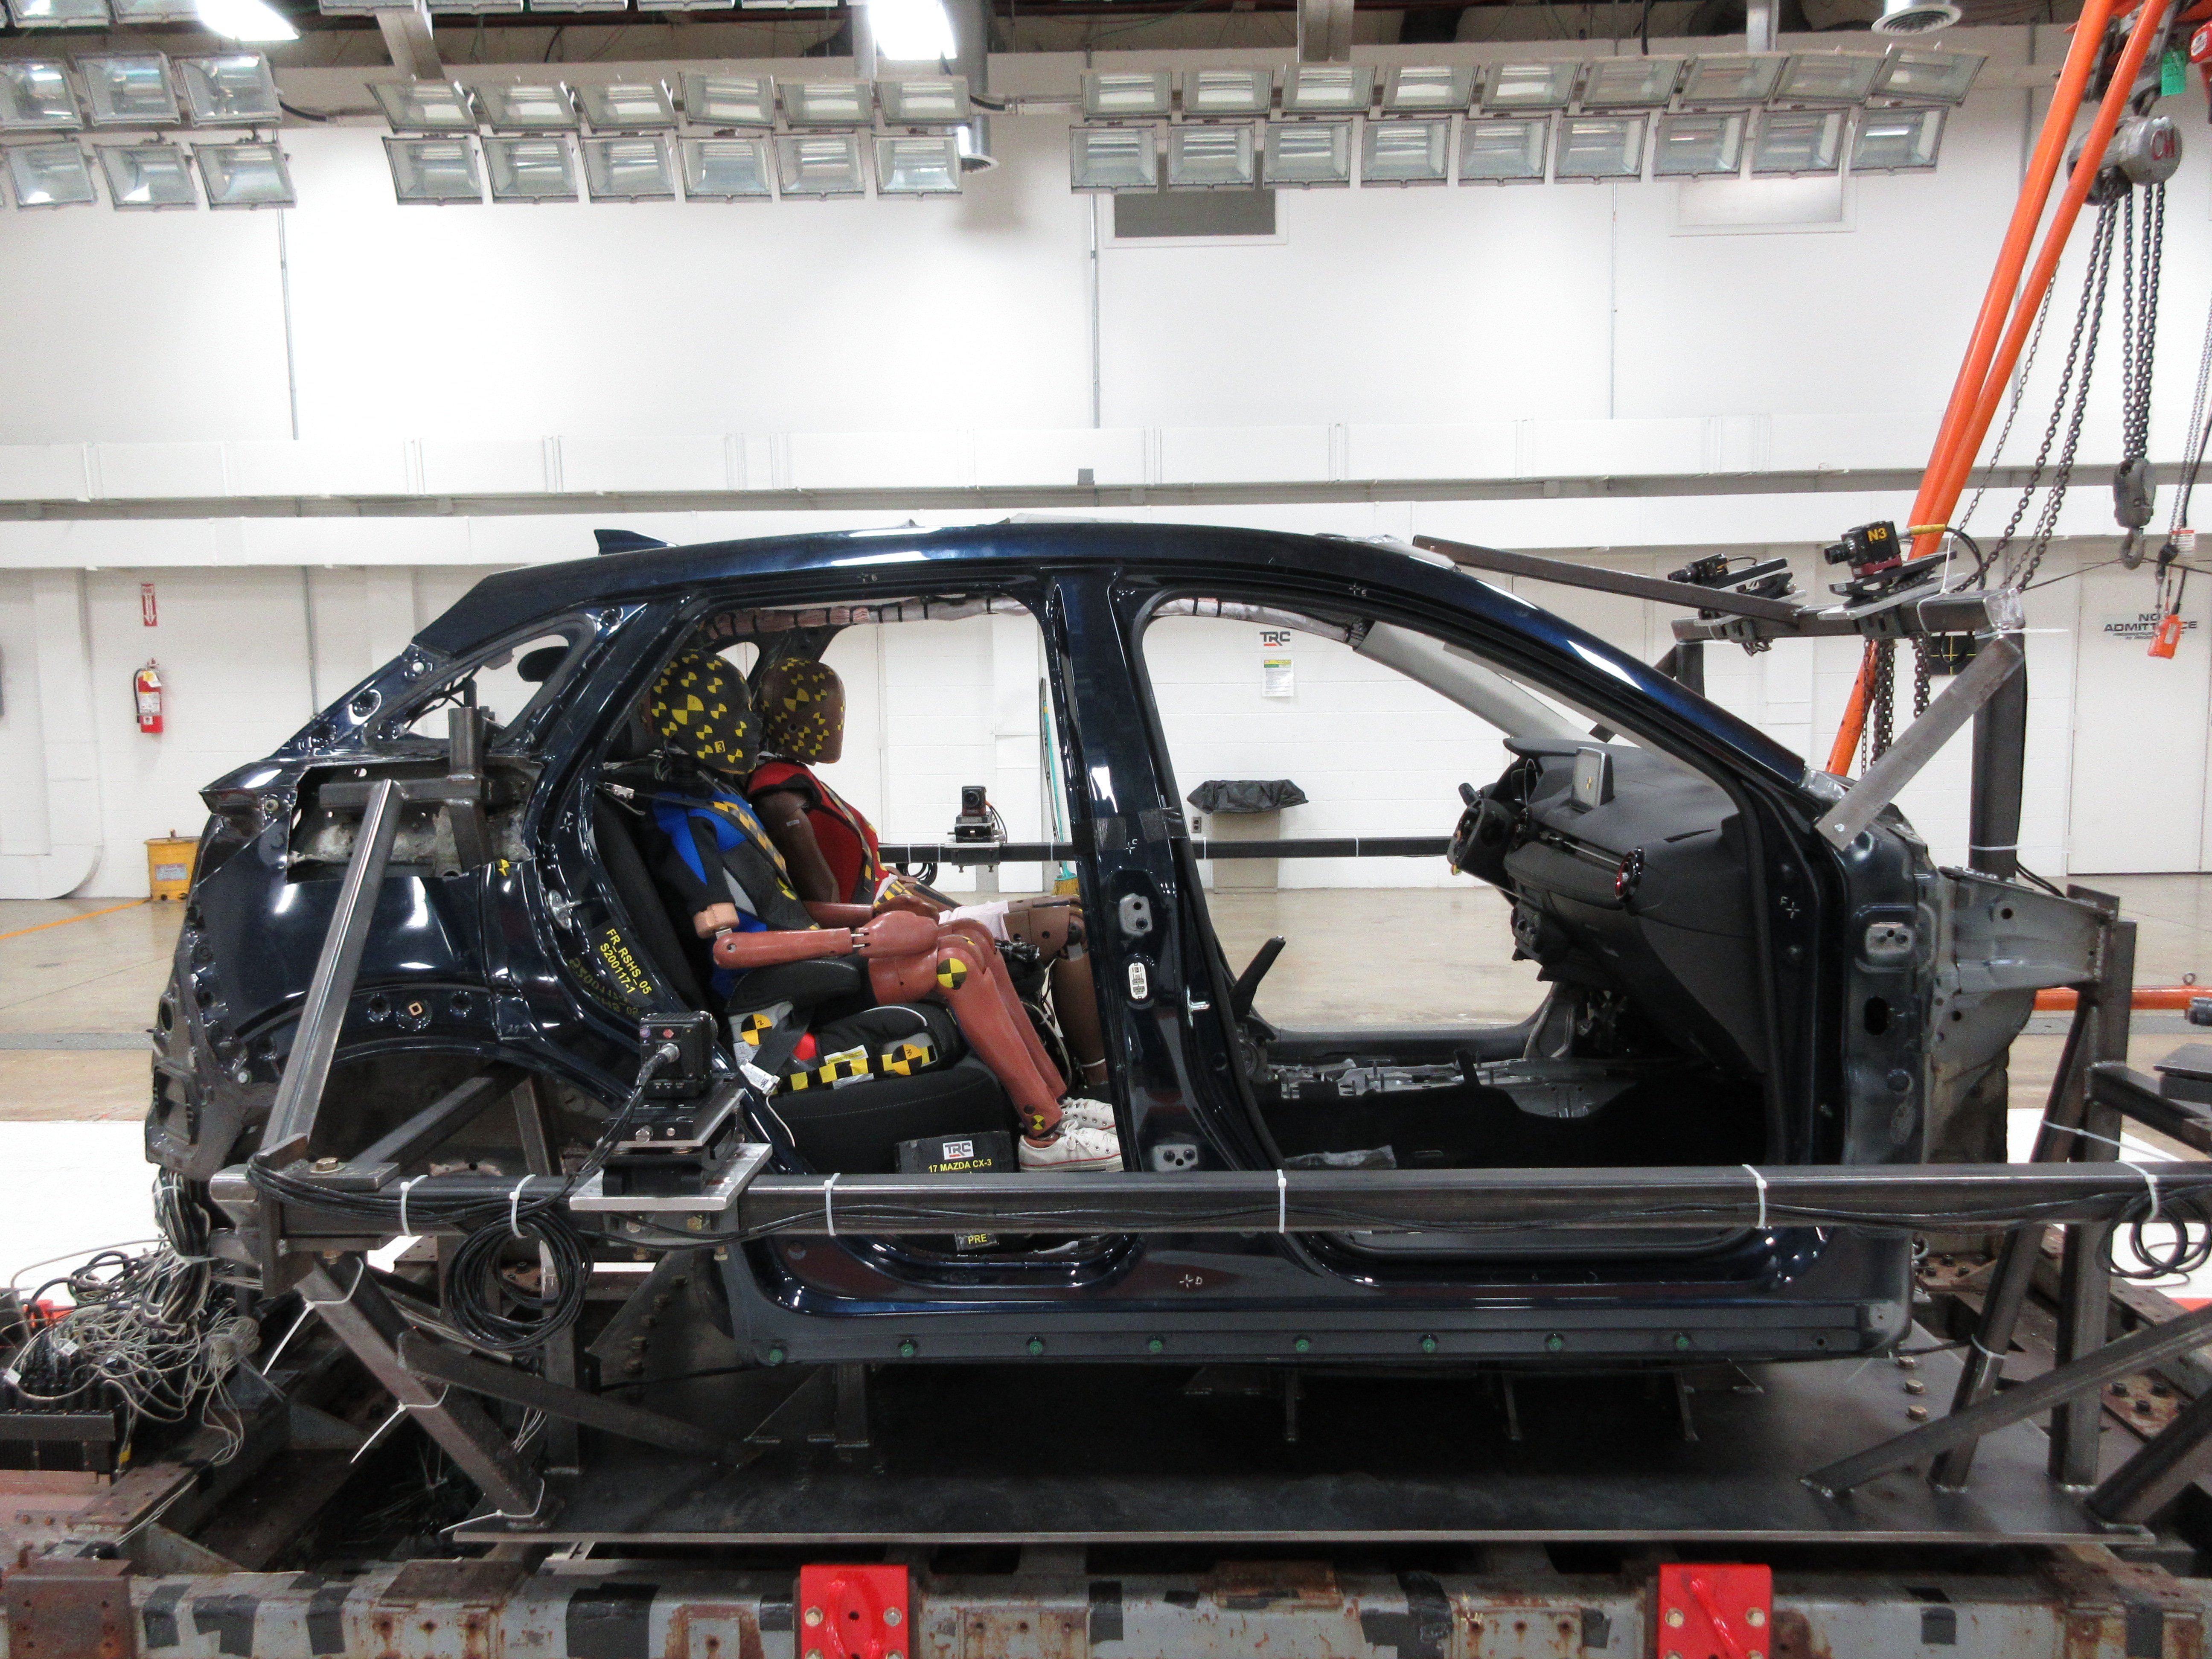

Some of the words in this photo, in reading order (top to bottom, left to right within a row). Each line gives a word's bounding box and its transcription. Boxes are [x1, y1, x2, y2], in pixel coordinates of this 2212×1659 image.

[1866, 527, 1888, 541] N3
[2138, 613, 2160, 621] NO
[1260, 631, 1291, 646] TRC
[718, 742, 724, 753] 3
[1780, 895, 1789, 905] F
[606, 928, 653, 995] FR_RSHS_05
[600, 943, 637, 993] S200117-1
[905, 1048, 912, 1057] 3
[944, 1142, 972, 1156] TRC
[928, 1164, 938, 1173] 17
[940, 1161, 971, 1172] MAZDA
[972, 1158, 992, 1168] CX-3
[968, 1234, 987, 1245] PRE
[1195, 1276, 1203, 1285] D
